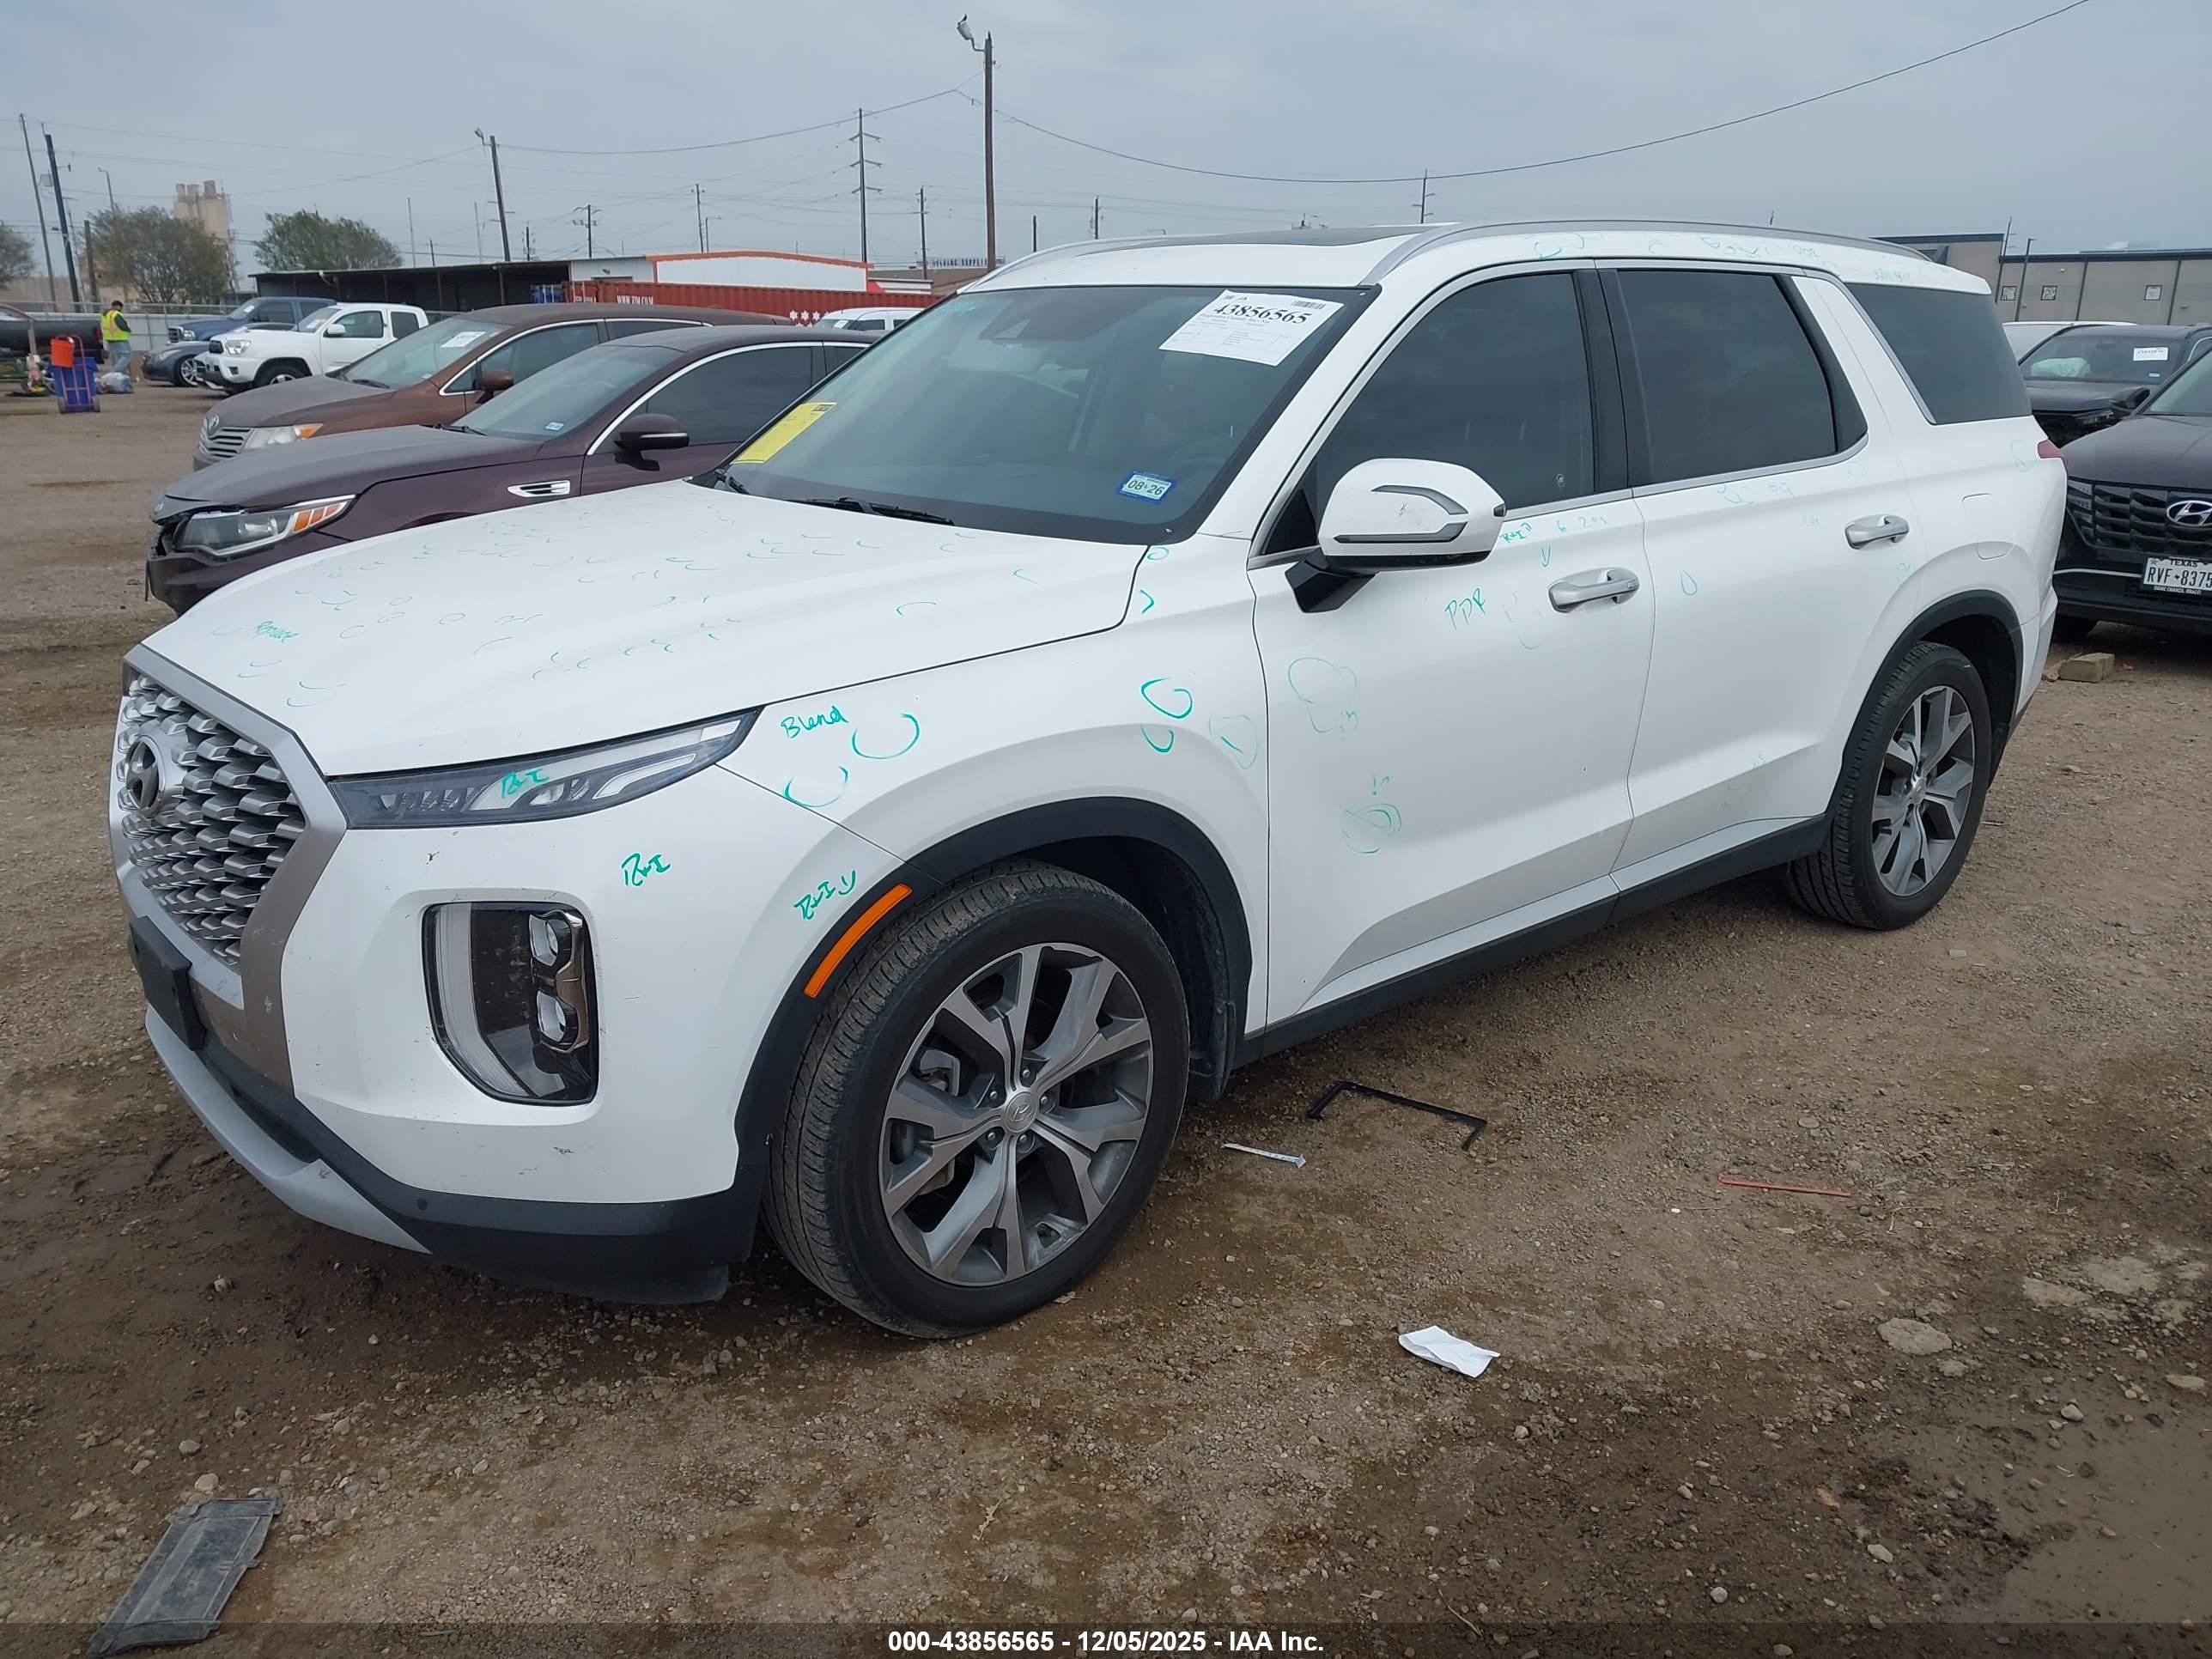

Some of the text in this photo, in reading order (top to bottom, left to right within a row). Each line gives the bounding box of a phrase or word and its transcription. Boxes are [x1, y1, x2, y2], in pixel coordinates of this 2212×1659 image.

[1213, 303, 1313, 325] 43856565
[1127, 480, 1165, 495] 08 26
[2169, 559, 2198, 568] TEXAS
[2147, 567, 2173, 584] RVF
[780, 705, 849, 738] Blend
